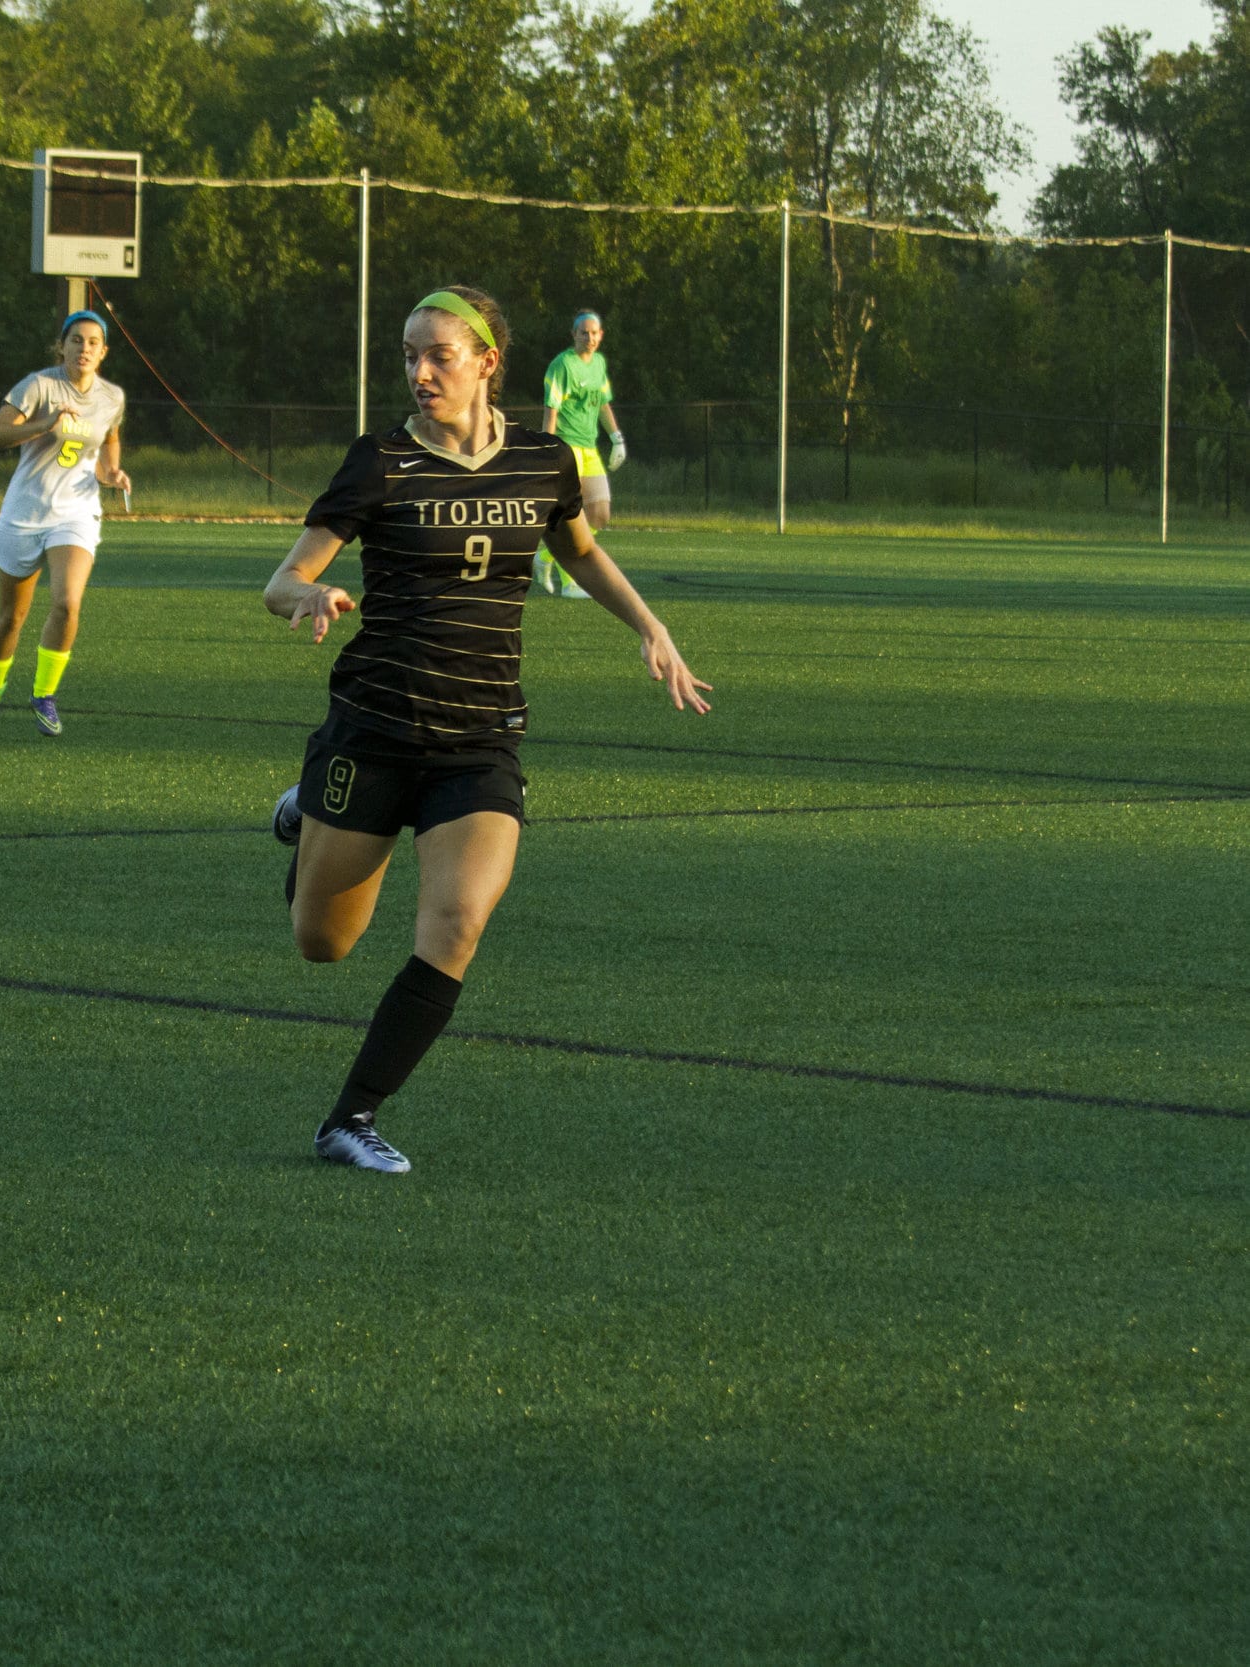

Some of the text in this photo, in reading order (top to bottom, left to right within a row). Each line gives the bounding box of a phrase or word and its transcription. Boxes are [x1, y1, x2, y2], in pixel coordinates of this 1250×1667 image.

[62, 418, 93, 437] NGU
[57, 440, 83, 468] 5
[460, 535, 492, 581] 9
[323, 755, 356, 814] 9
